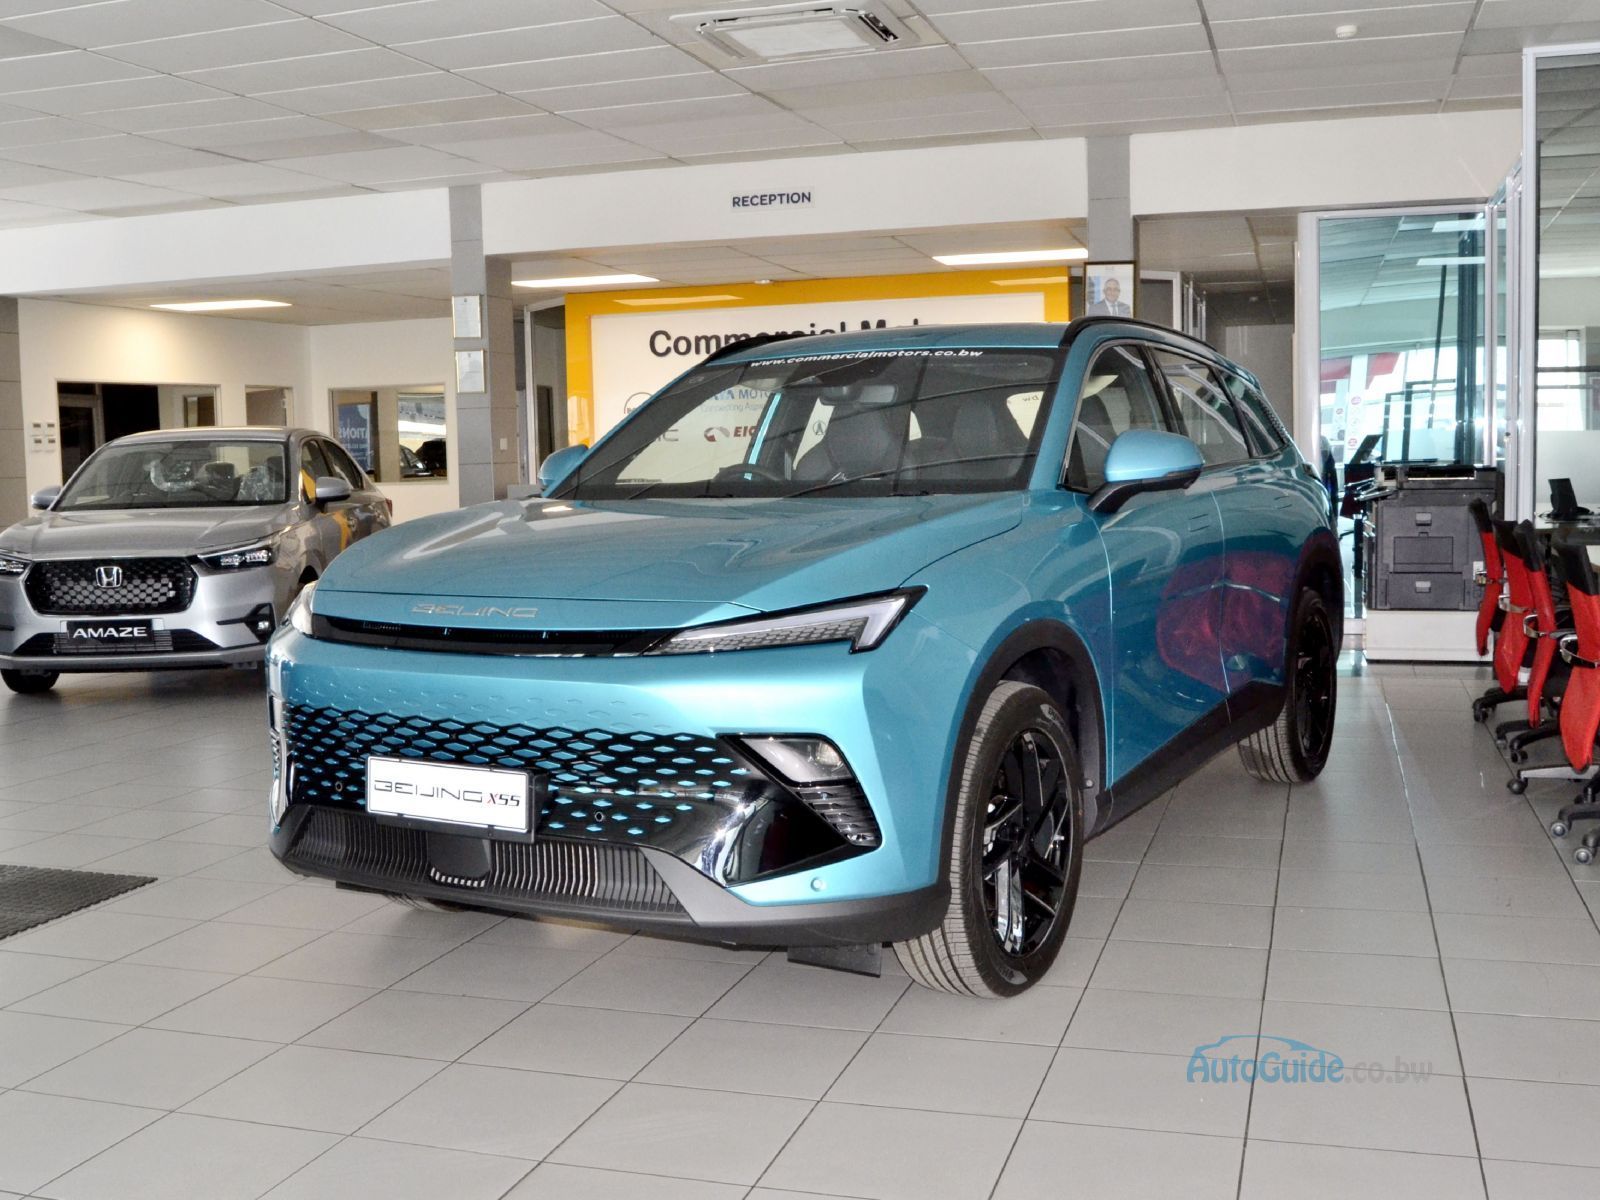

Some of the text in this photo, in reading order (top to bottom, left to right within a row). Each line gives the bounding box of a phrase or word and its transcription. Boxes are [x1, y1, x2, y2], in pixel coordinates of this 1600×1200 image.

[732, 191, 811, 207] RECEPTION
[750, 349, 984, 368] www.commercialmotors.co.bw
[411, 603, 538, 618] BEIJING
[73, 626, 148, 639] AMAZE
[374, 779, 521, 807] BEIJING X55
